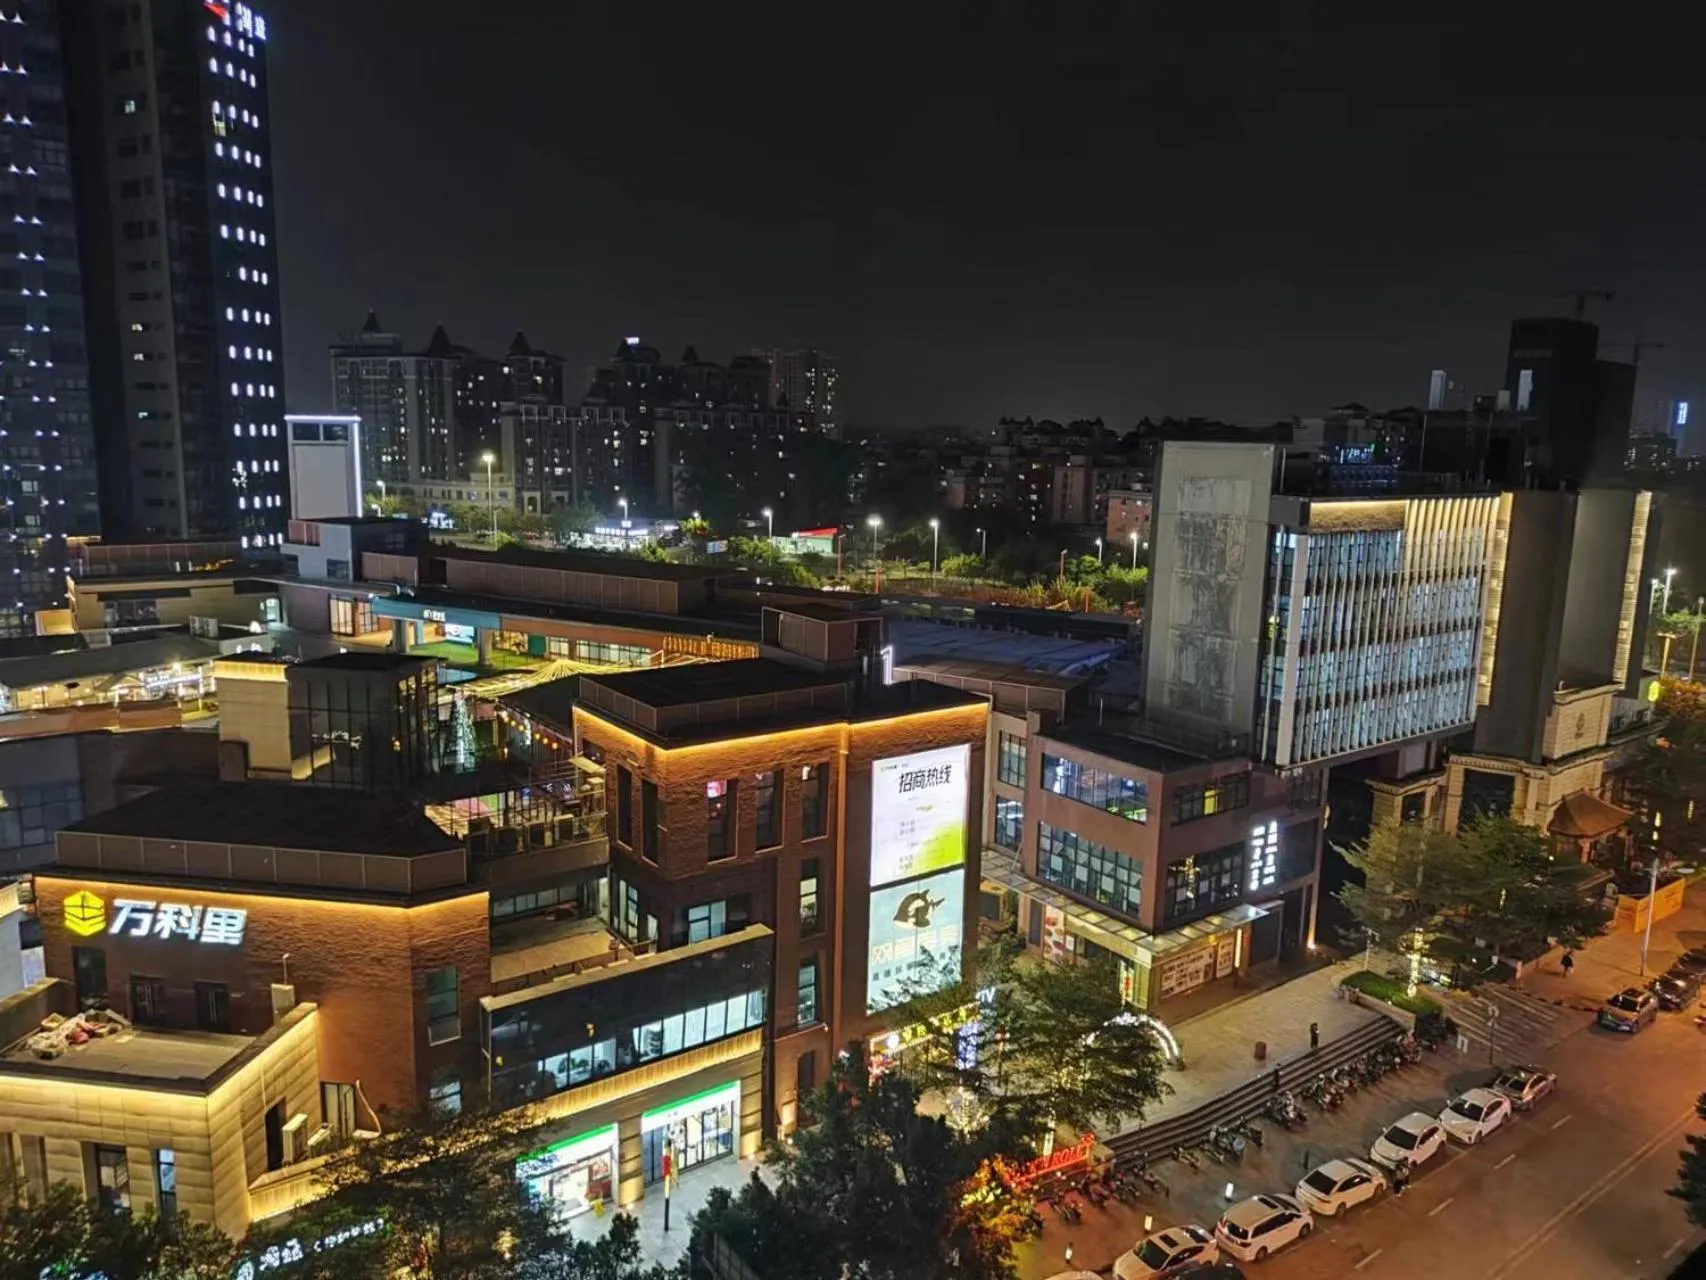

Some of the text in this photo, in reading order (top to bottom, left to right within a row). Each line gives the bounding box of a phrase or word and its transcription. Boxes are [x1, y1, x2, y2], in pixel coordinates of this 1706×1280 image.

[899, 765, 952, 793] 招商热线
[108, 898, 248, 945] 万科里
